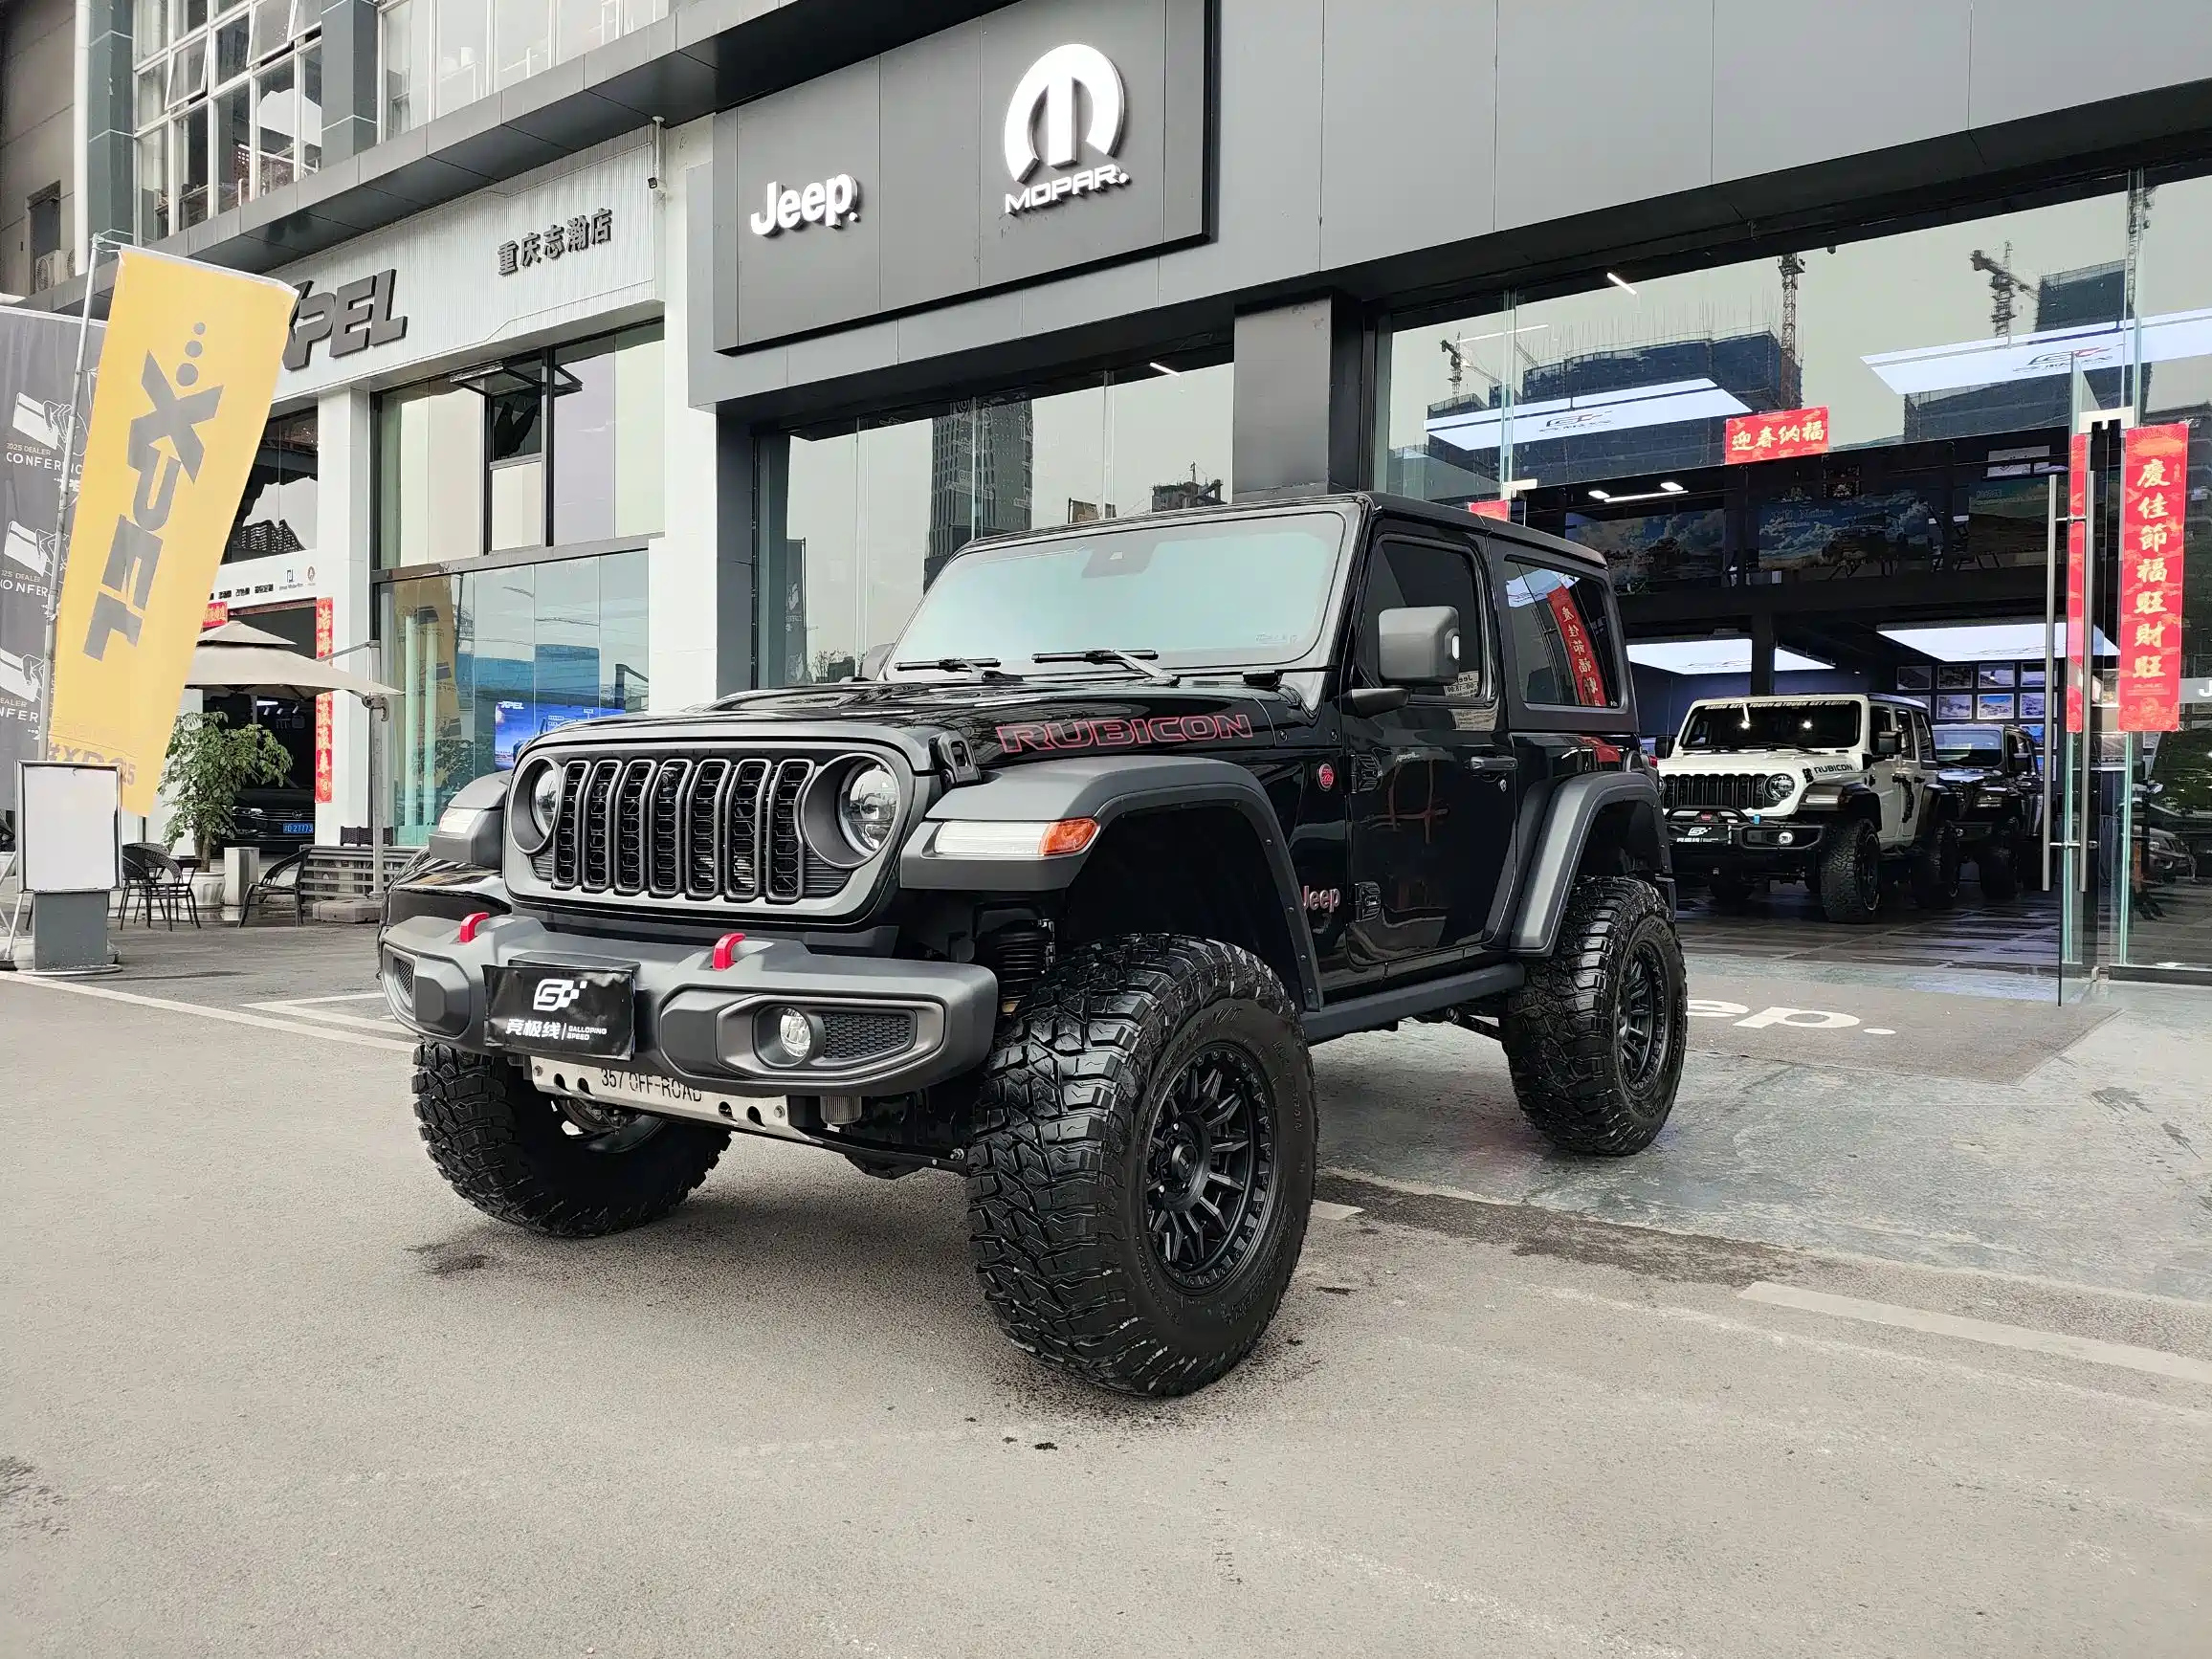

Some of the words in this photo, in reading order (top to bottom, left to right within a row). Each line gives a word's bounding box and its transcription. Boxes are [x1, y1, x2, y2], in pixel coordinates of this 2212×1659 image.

[498, 208, 613, 276] 重庆志瀚店
[24, 445, 52, 456] DEALER
[1732, 420, 1825, 452] 迎春纳福
[2132, 458, 2171, 679] 慶佳節福旺財旺
[995, 715, 1254, 753] RUBICON
[1814, 763, 1853, 774] RUBICON
[1302, 885, 1341, 913] Jeep
[505, 1018, 562, 1040] 竞极线
[567, 1025, 608, 1035] GALLOPING
[1686, 999, 1897, 1035] ep.
[566, 1032, 590, 1041] SPEED
[601, 1069, 624, 1089] 357
[629, 1073, 703, 1102] OFF-ROAD
